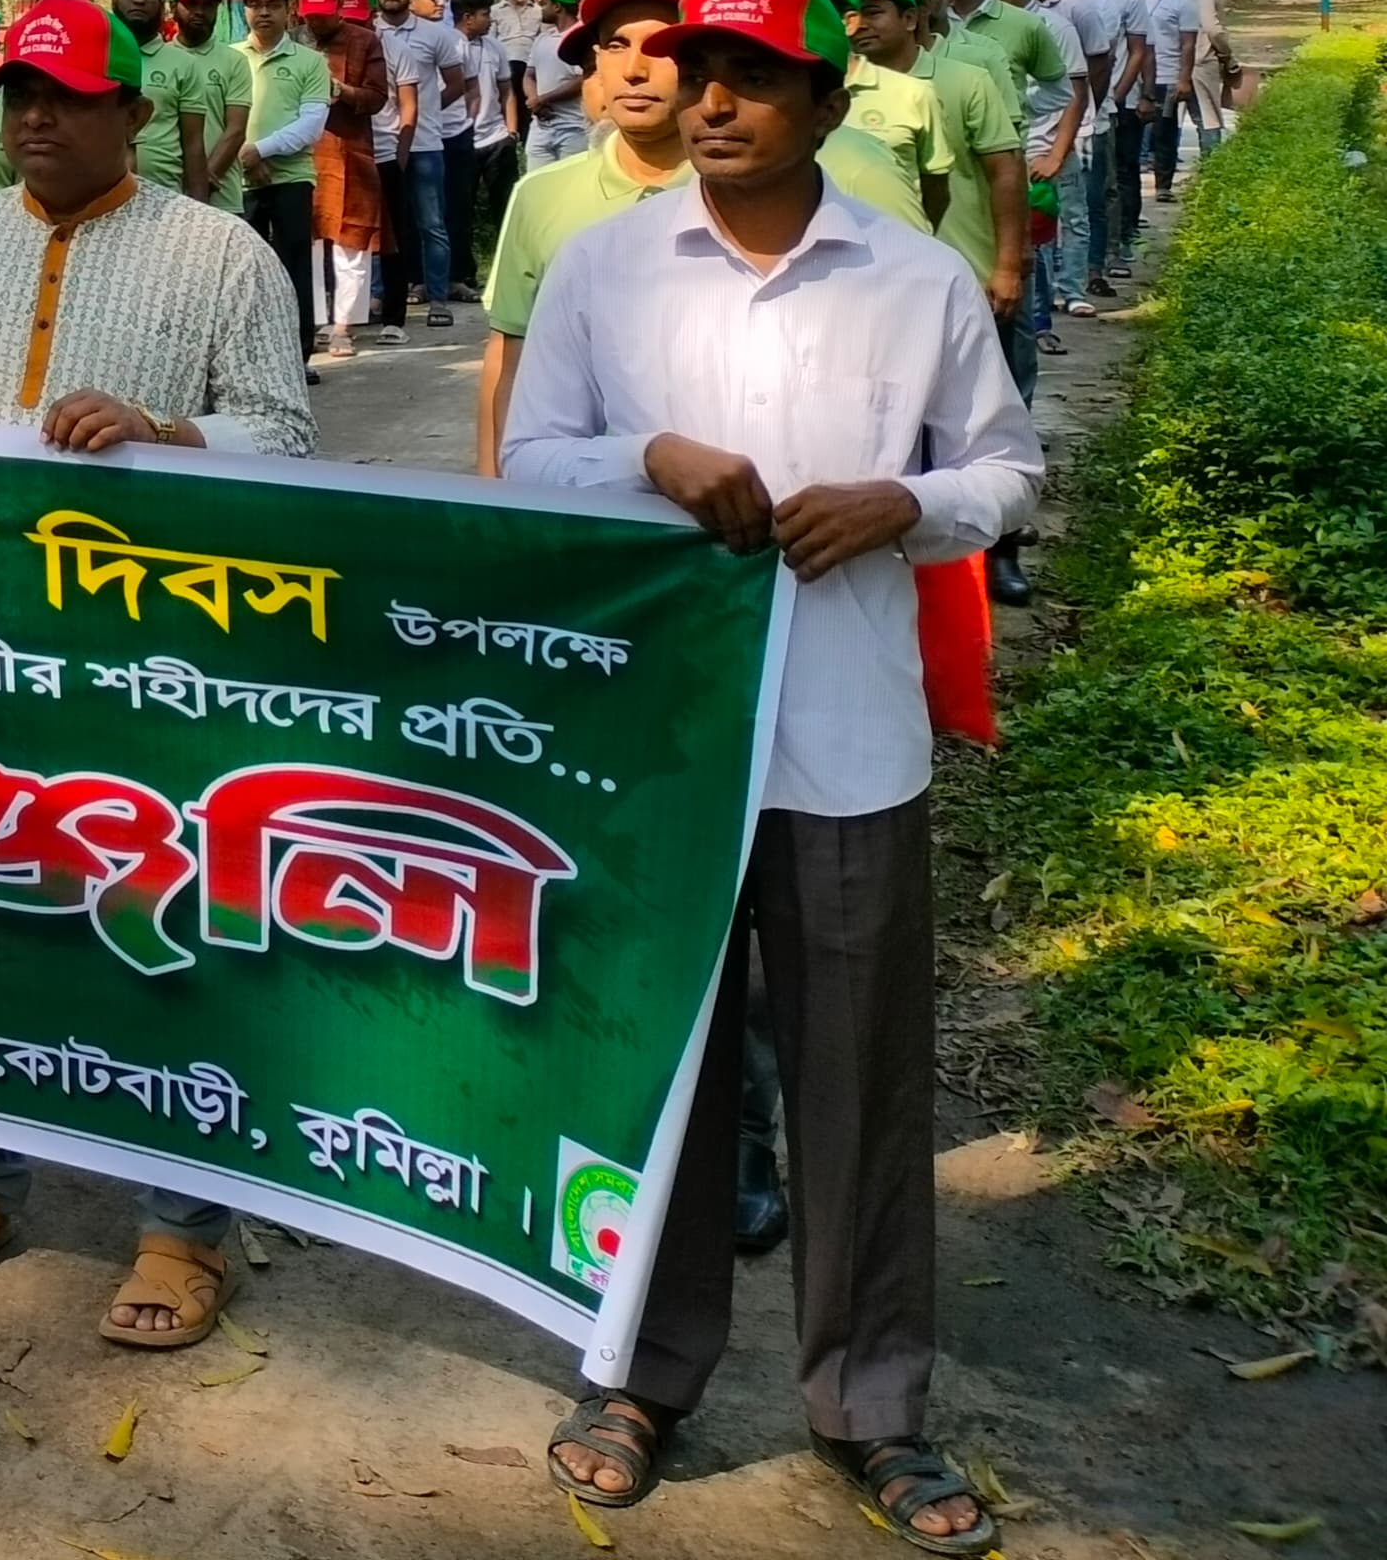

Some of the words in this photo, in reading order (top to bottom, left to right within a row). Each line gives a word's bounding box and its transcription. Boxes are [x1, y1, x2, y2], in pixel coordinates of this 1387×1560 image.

[24, 509, 344, 643] দিবস
[385, 599, 632, 676] উপলক্ষে
[92, 655, 379, 741] শহীদদের
[289, 1103, 490, 1215] কুমিল্লা
